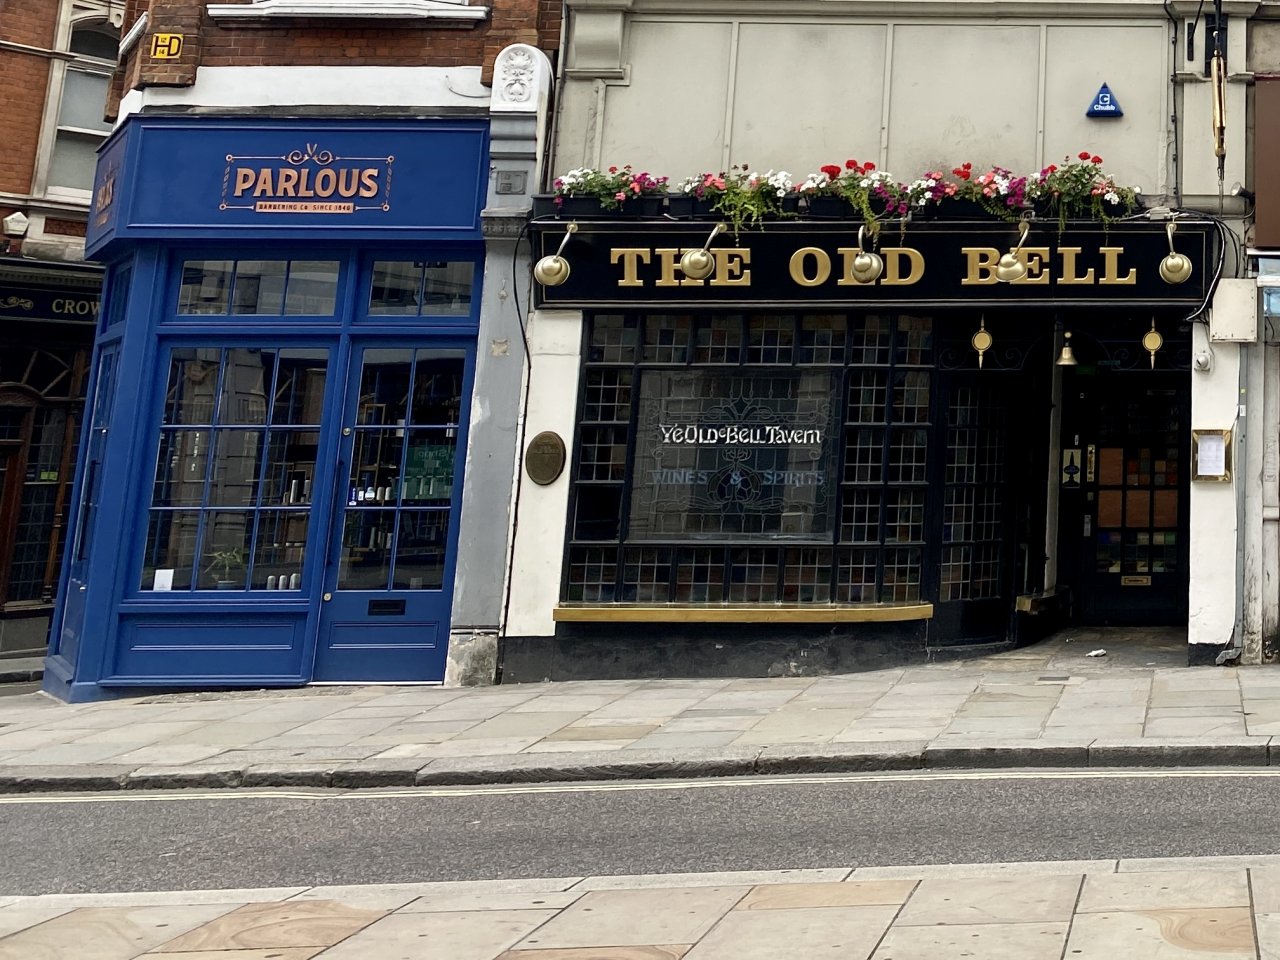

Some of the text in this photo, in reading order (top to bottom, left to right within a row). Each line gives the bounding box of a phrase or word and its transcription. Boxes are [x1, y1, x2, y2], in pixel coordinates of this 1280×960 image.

[233, 167, 379, 198] PARLOUS
[258, 203, 298, 211] BARBERING
[313, 204, 332, 212] SINCE
[610, 246, 752, 287] THE
[961, 246, 1137, 285] BELL
[652, 469, 824, 487] WINES & SPIRITS
